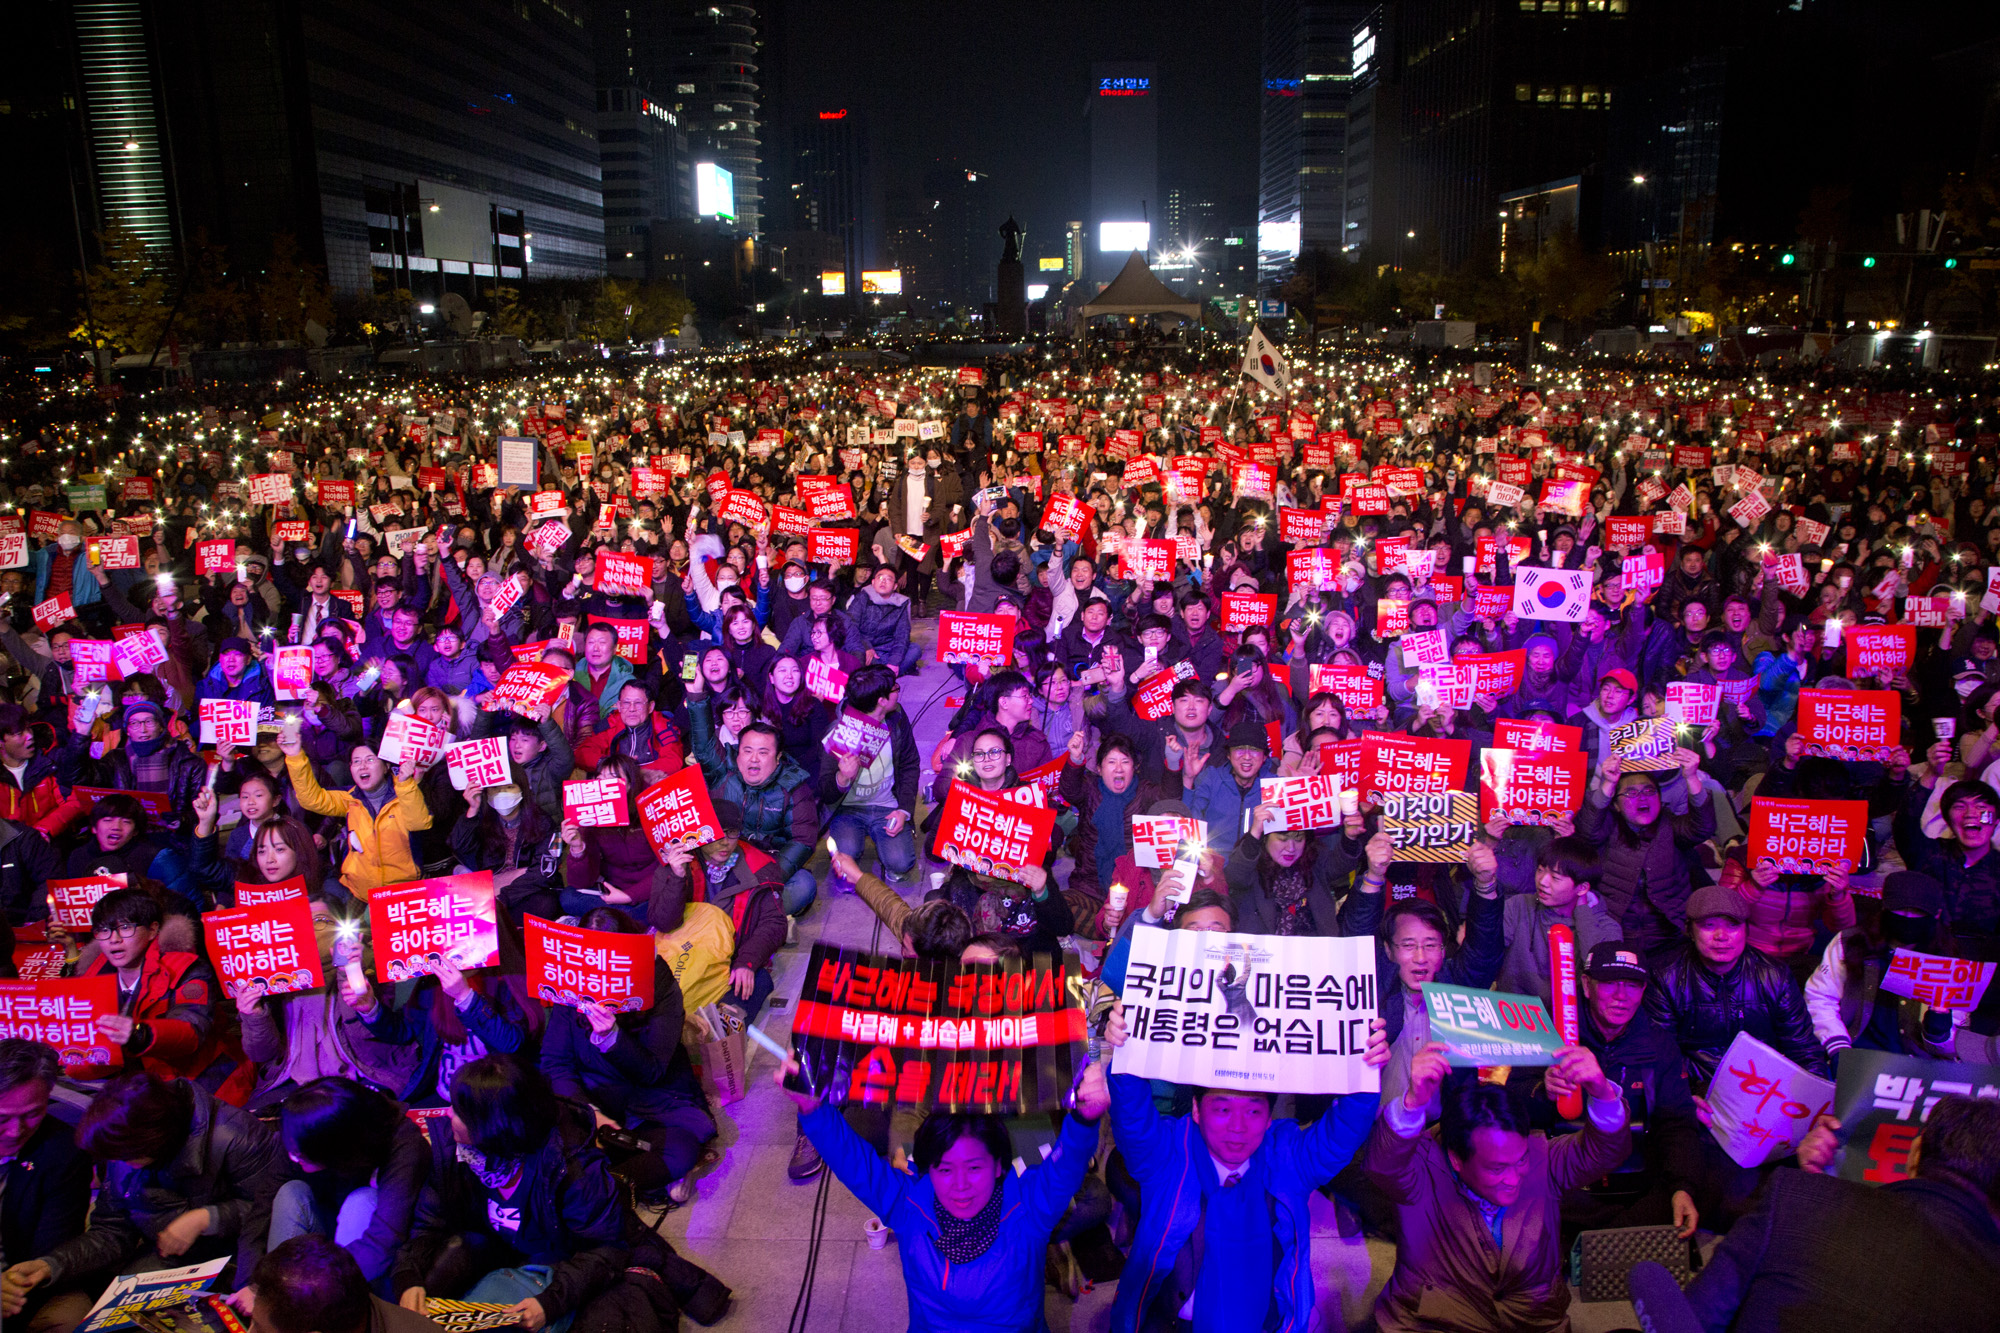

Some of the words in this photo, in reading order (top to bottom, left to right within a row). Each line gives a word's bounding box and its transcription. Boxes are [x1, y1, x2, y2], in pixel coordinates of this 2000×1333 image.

[1099, 77, 1151, 90] 조선일보
[898, 422, 916, 433] 하야
[926, 425, 941, 436] 하라
[1177, 459, 1204, 468] 박근혜는
[1307, 450, 1330, 458] 박근혜는
[1307, 457, 1330, 465] 하야하라
[1678, 457, 1704, 465] 하야하라
[1679, 450, 1705, 459] 박근혜는
[1124, 468, 1153, 482] 하야하라
[1125, 460, 1151, 472] 박근혜는
[1239, 469, 1271, 481] 박근혜는
[1934, 461, 1966, 472] 박근혜
[250, 474, 292, 492] 내려와
[638, 473, 666, 483] 박근혜는
[638, 481, 666, 491] 하야하라
[1388, 473, 1417, 482] 박근혜는
[1501, 473, 1526, 482] 박근혜!
[250, 488, 292, 505] 박근혜
[323, 484, 350, 493] 박근혜는
[324, 492, 350, 501] 하야하라
[534, 491, 562, 503] 박근혜
[812, 491, 845, 505] 박근혜는
[1356, 487, 1387, 498] 퇴진하라
[731, 493, 764, 512] 박근혜는
[813, 501, 848, 516] 하야하라
[1053, 500, 1085, 523] 박근혜는
[1358, 500, 1387, 511] 박근혜!
[728, 503, 764, 522] 하야하라
[779, 512, 810, 526] 박근혜는
[1049, 510, 1082, 531] 하야하라
[1287, 514, 1323, 526] 박근혜는
[1654, 511, 1684, 524] 박근혜
[278, 529, 307, 539] OUT!
[282, 522, 305, 530] 박근혜
[1611, 523, 1646, 533] 박근혜는
[1662, 522, 1683, 534] 퇴진
[550, 529, 572, 548] 퇴진
[816, 535, 851, 547] 박근혜는
[1611, 532, 1645, 543] 하야하라
[200, 544, 229, 556] 박근혜
[816, 546, 851, 558] 하야하라
[1128, 545, 1168, 558] 박근혜는
[604, 557, 644, 575] 박근혜는
[1127, 558, 1168, 571] 하야하라
[1293, 557, 1332, 569] 박근혜는
[1622, 556, 1648, 572] 이게
[602, 571, 644, 588] 하야하라
[34, 598, 59, 619] 퇴진!
[493, 581, 523, 617] 퇴진
[1230, 600, 1269, 613] 박근혜는
[1905, 598, 1932, 612] 이게
[47, 607, 75, 625] 박근혜
[1229, 612, 1268, 623] 하야하라
[950, 621, 1003, 638] 박근혜는
[114, 630, 156, 660] 박근혜
[949, 637, 1002, 654] 하야하라
[1402, 630, 1442, 651] 박근혜
[1857, 634, 1906, 648] 박근혜는
[70, 642, 110, 664] 박근혜
[279, 655, 311, 669] 박근혜
[1417, 647, 1445, 664] 퇴진
[1859, 650, 1906, 665] 하야하라
[75, 663, 107, 682] 퇴진
[282, 667, 306, 681] 퇴진!
[807, 657, 830, 680] 이게
[1420, 664, 1473, 687] 박근혜
[503, 668, 551, 690] 박근혜는
[1321, 675, 1374, 691] 박근혜는
[495, 684, 545, 704] 하야하라
[1437, 686, 1471, 709] 퇴진
[1667, 684, 1716, 703] 박근혜
[200, 700, 252, 725] 박근혜
[1682, 704, 1713, 724] 퇴진
[1814, 702, 1886, 724] 박근혜는
[215, 723, 250, 744] 퇴진
[386, 719, 445, 748] 박근혜
[1506, 730, 1567, 752] 박근혜는
[1609, 719, 1655, 746] 우리가
[1812, 724, 1887, 744] 하야하라
[400, 746, 438, 768] 퇴진
[446, 737, 502, 769] 박근혜
[1377, 747, 1452, 772] 박근혜는
[466, 759, 505, 788] 퇴진
[1374, 770, 1450, 793] 하야하라
[1505, 765, 1571, 786] 박근혜는
[564, 778, 622, 805] 재벌도
[1260, 775, 1334, 809] 박근혜
[1500, 787, 1571, 808] 하야하라
[644, 787, 693, 822] 박근혜는
[1384, 793, 1450, 820] 이것이
[576, 802, 616, 827] 공범
[960, 798, 1034, 843] 박근혜는
[1285, 801, 1334, 831] 퇴진
[1768, 812, 1849, 835] 박근혜는
[651, 806, 701, 845] 하야하라
[1132, 818, 1202, 847] 박근혜
[1385, 821, 1473, 849] 국가인가
[953, 823, 1029, 866] 하야하라
[1765, 835, 1848, 857] 하야하라
[387, 894, 474, 926] 박근혜는
[215, 920, 294, 951] 박근혜는
[390, 920, 477, 954] 하야하라
[220, 945, 300, 978] 하야하라
[542, 936, 632, 973] 박근혜는
[1889, 954, 1985, 984] 박근혜
[543, 962, 634, 997] 하야하라
[818, 958, 937, 1013] 박근혜는
[948, 964, 1066, 1014] 국정에서
[1125, 962, 1215, 1005] 국민의
[1255, 972, 1374, 1011] 마음속에
[1911, 984, 1974, 1009] 퇴진
[1430, 991, 1502, 1031] 박근혜
[1497, 999, 1550, 1034] OUT
[841, 1010, 898, 1046] 박근혜
[919, 1016, 977, 1049] 최순실
[982, 1015, 1039, 1048] 게이트
[1121, 1004, 1240, 1051] 대통령은
[1253, 1017, 1374, 1056] 없습니다
[726, 1062, 736, 1096] BURGER
[848, 1046, 931, 1105] 손을
